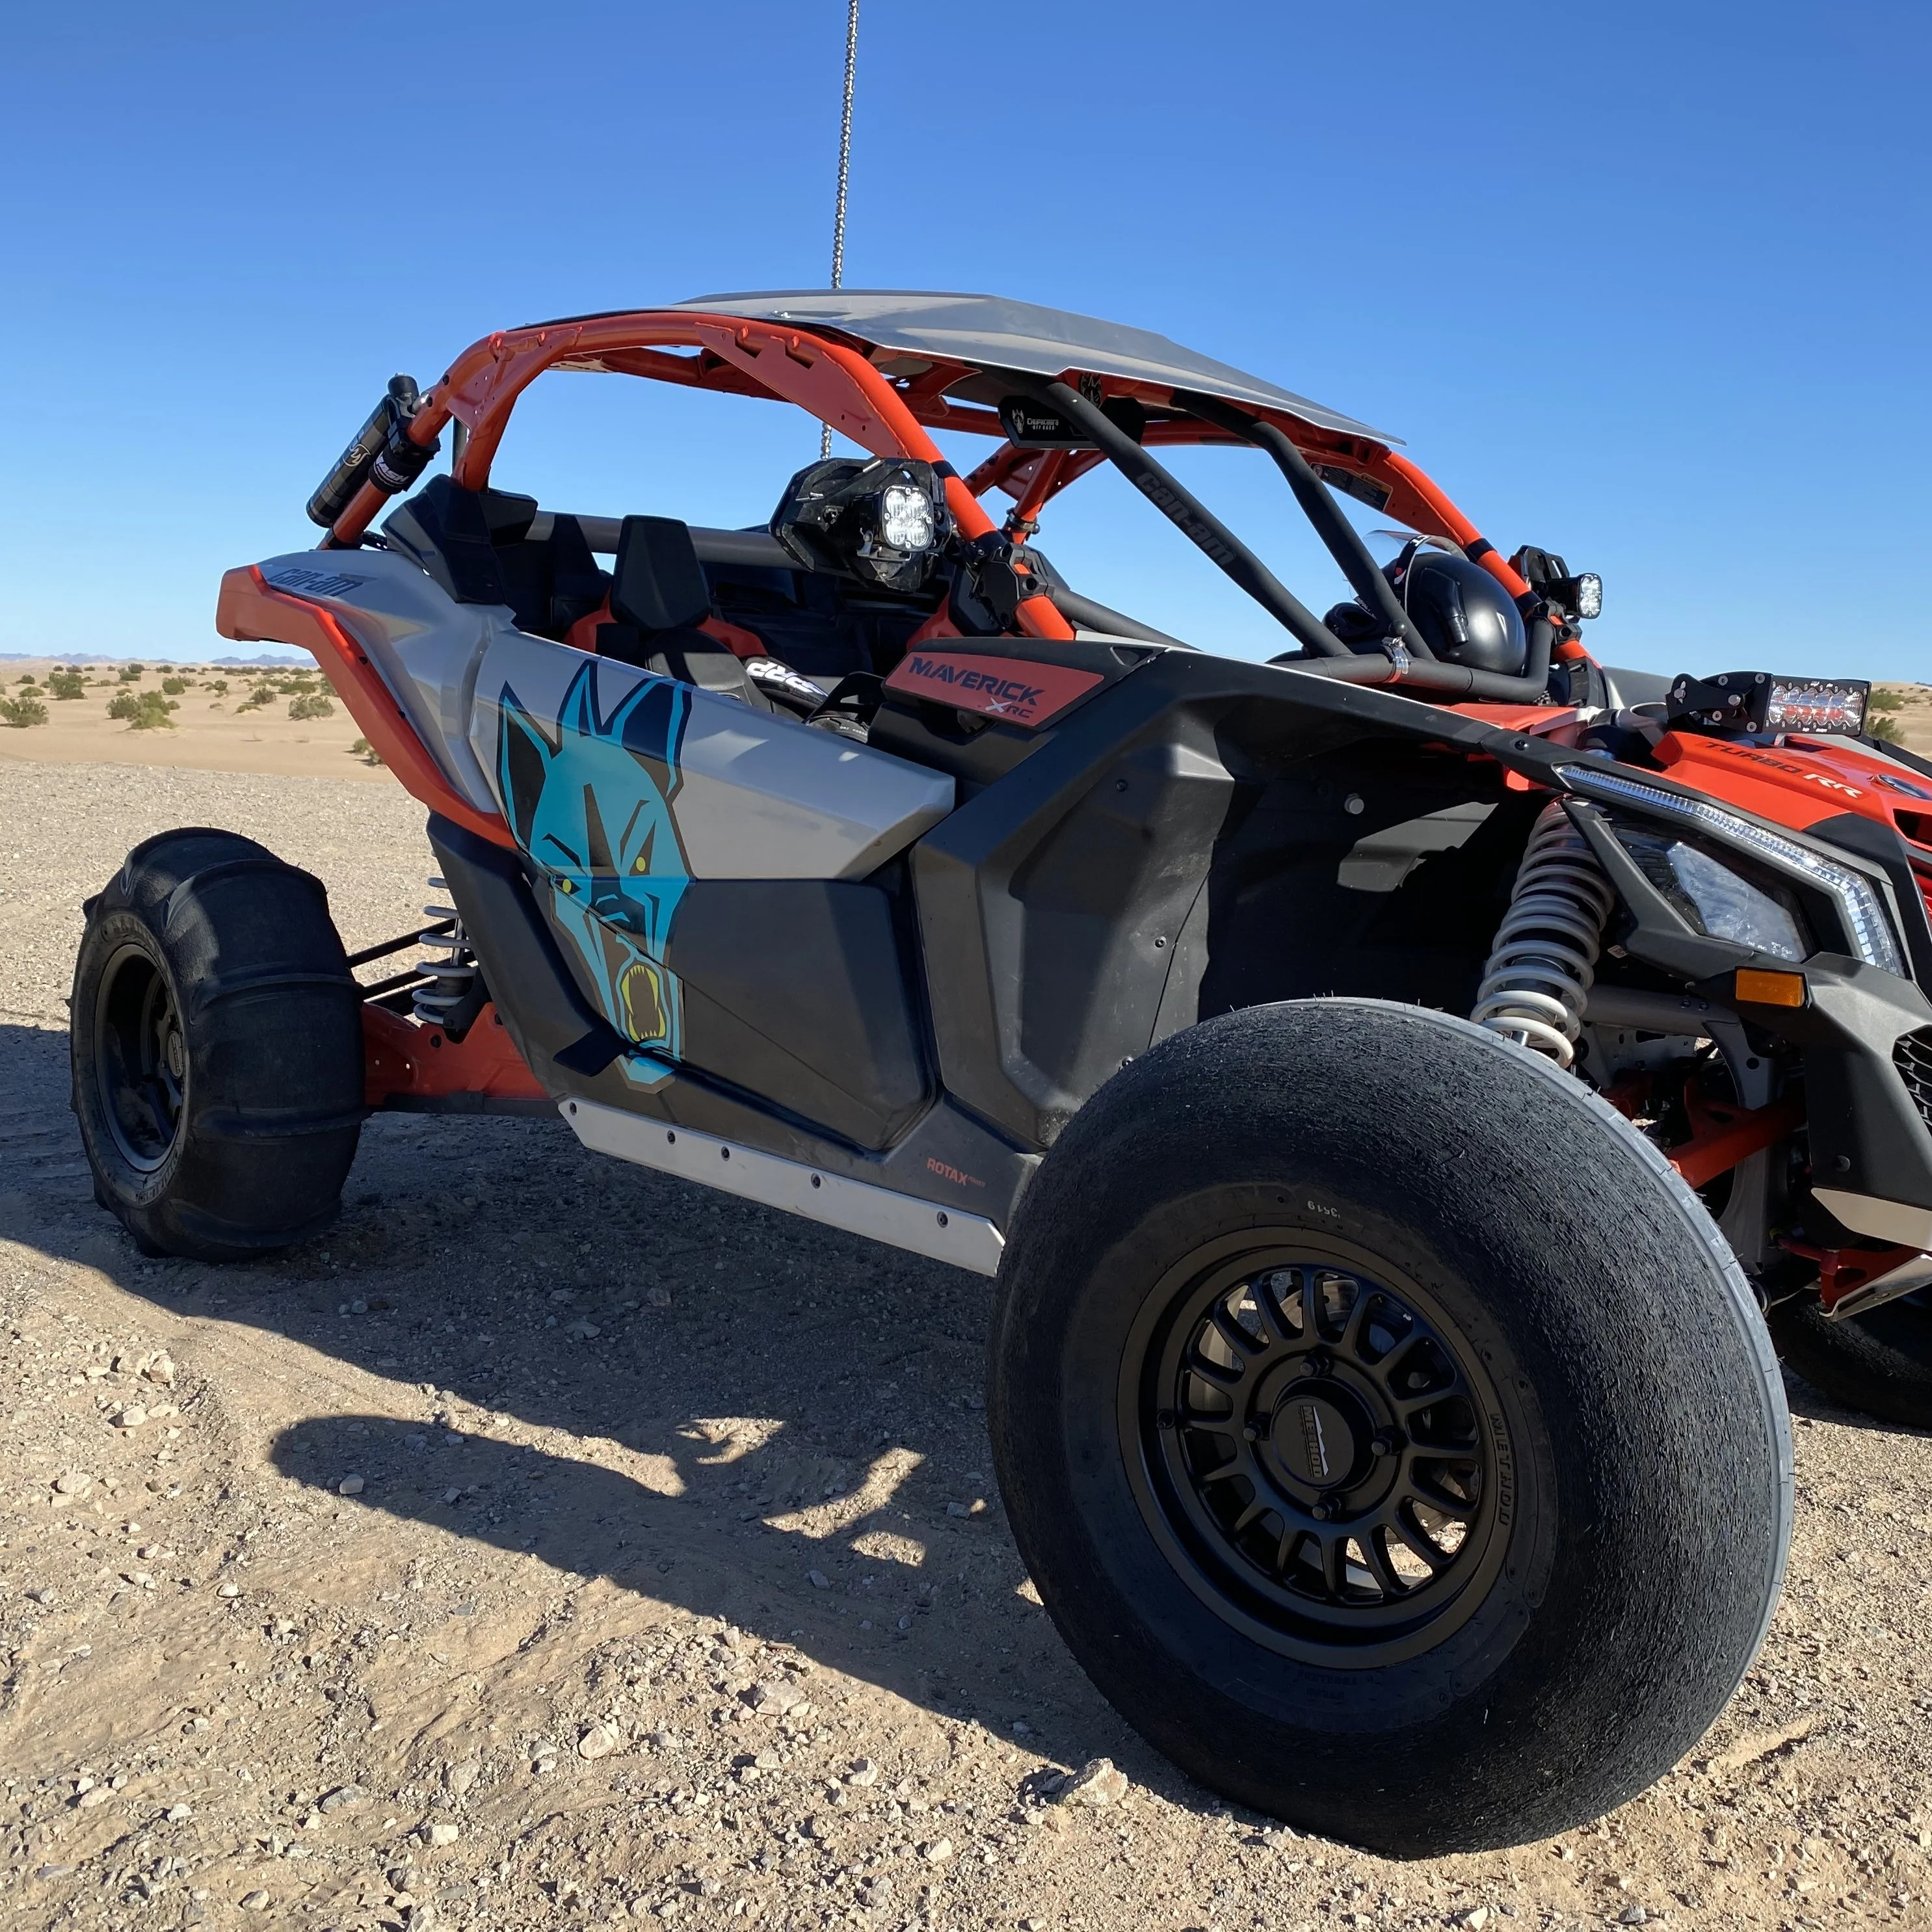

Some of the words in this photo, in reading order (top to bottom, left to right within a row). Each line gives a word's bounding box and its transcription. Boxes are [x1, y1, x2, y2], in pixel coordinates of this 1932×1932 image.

[908, 656, 1046, 706] MAVERICK
[1705, 741, 1803, 774] TURBO
[1803, 773, 1864, 799] RR
[927, 1157, 969, 1187] ROTAX
[1490, 1412, 1514, 1526] METHOD
